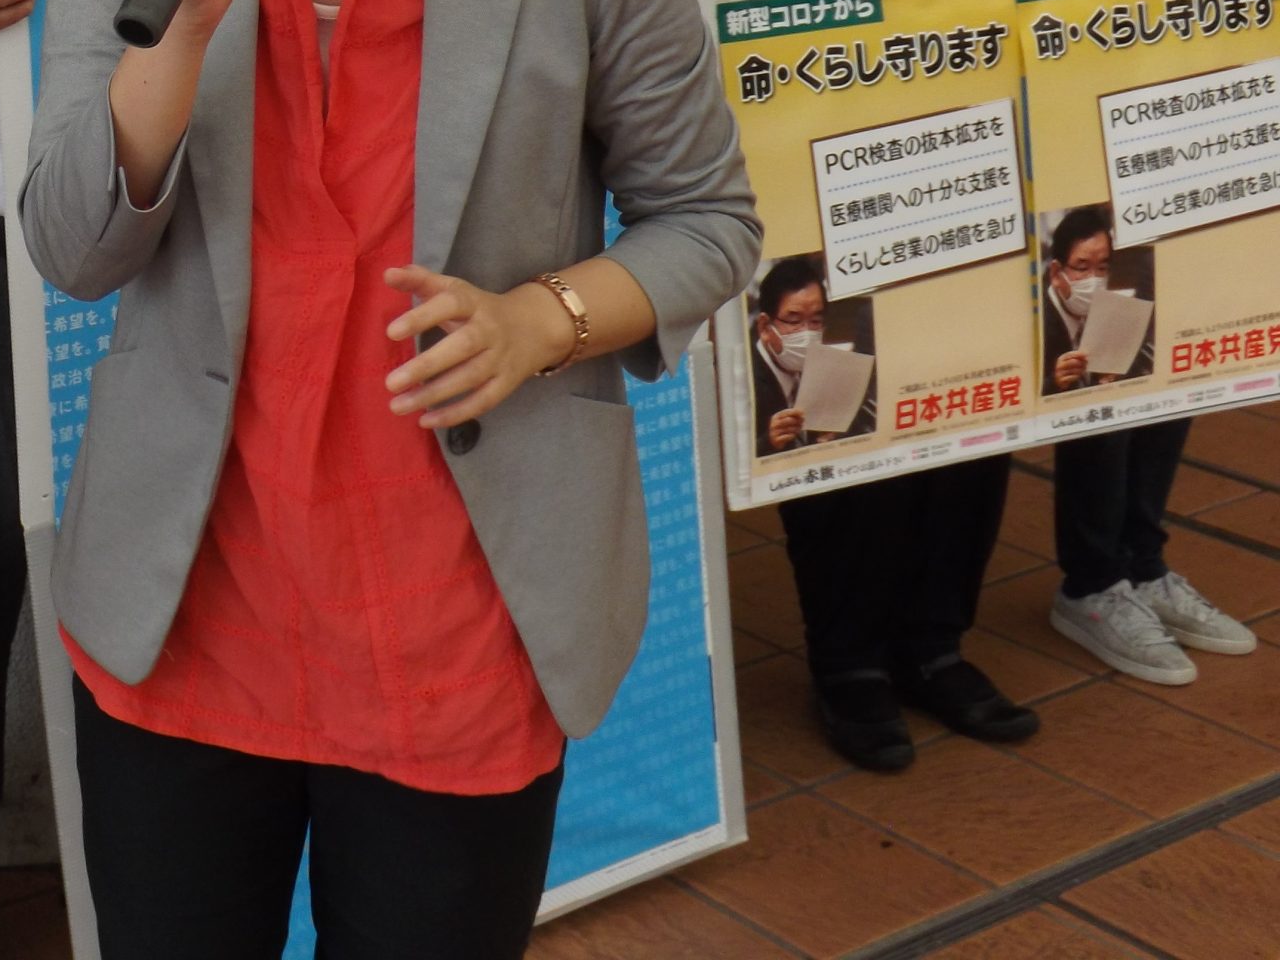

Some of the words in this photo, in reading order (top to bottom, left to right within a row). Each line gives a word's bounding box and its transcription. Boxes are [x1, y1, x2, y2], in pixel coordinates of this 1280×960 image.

[737, 22, 1008, 102] 命・くらし守ります
[1110, 75, 1276, 128] PCR検査の抜本拡充を
[825, 117, 1004, 174] PCR検査の抜本拡充を
[1116, 122, 1280, 179] 医療機関への十分な支援を
[830, 166, 1011, 227] 医療機関への十分な支援を
[836, 214, 1017, 275] くらしと営業の補償を急げ
[895, 375, 1022, 430] 日本共産党
